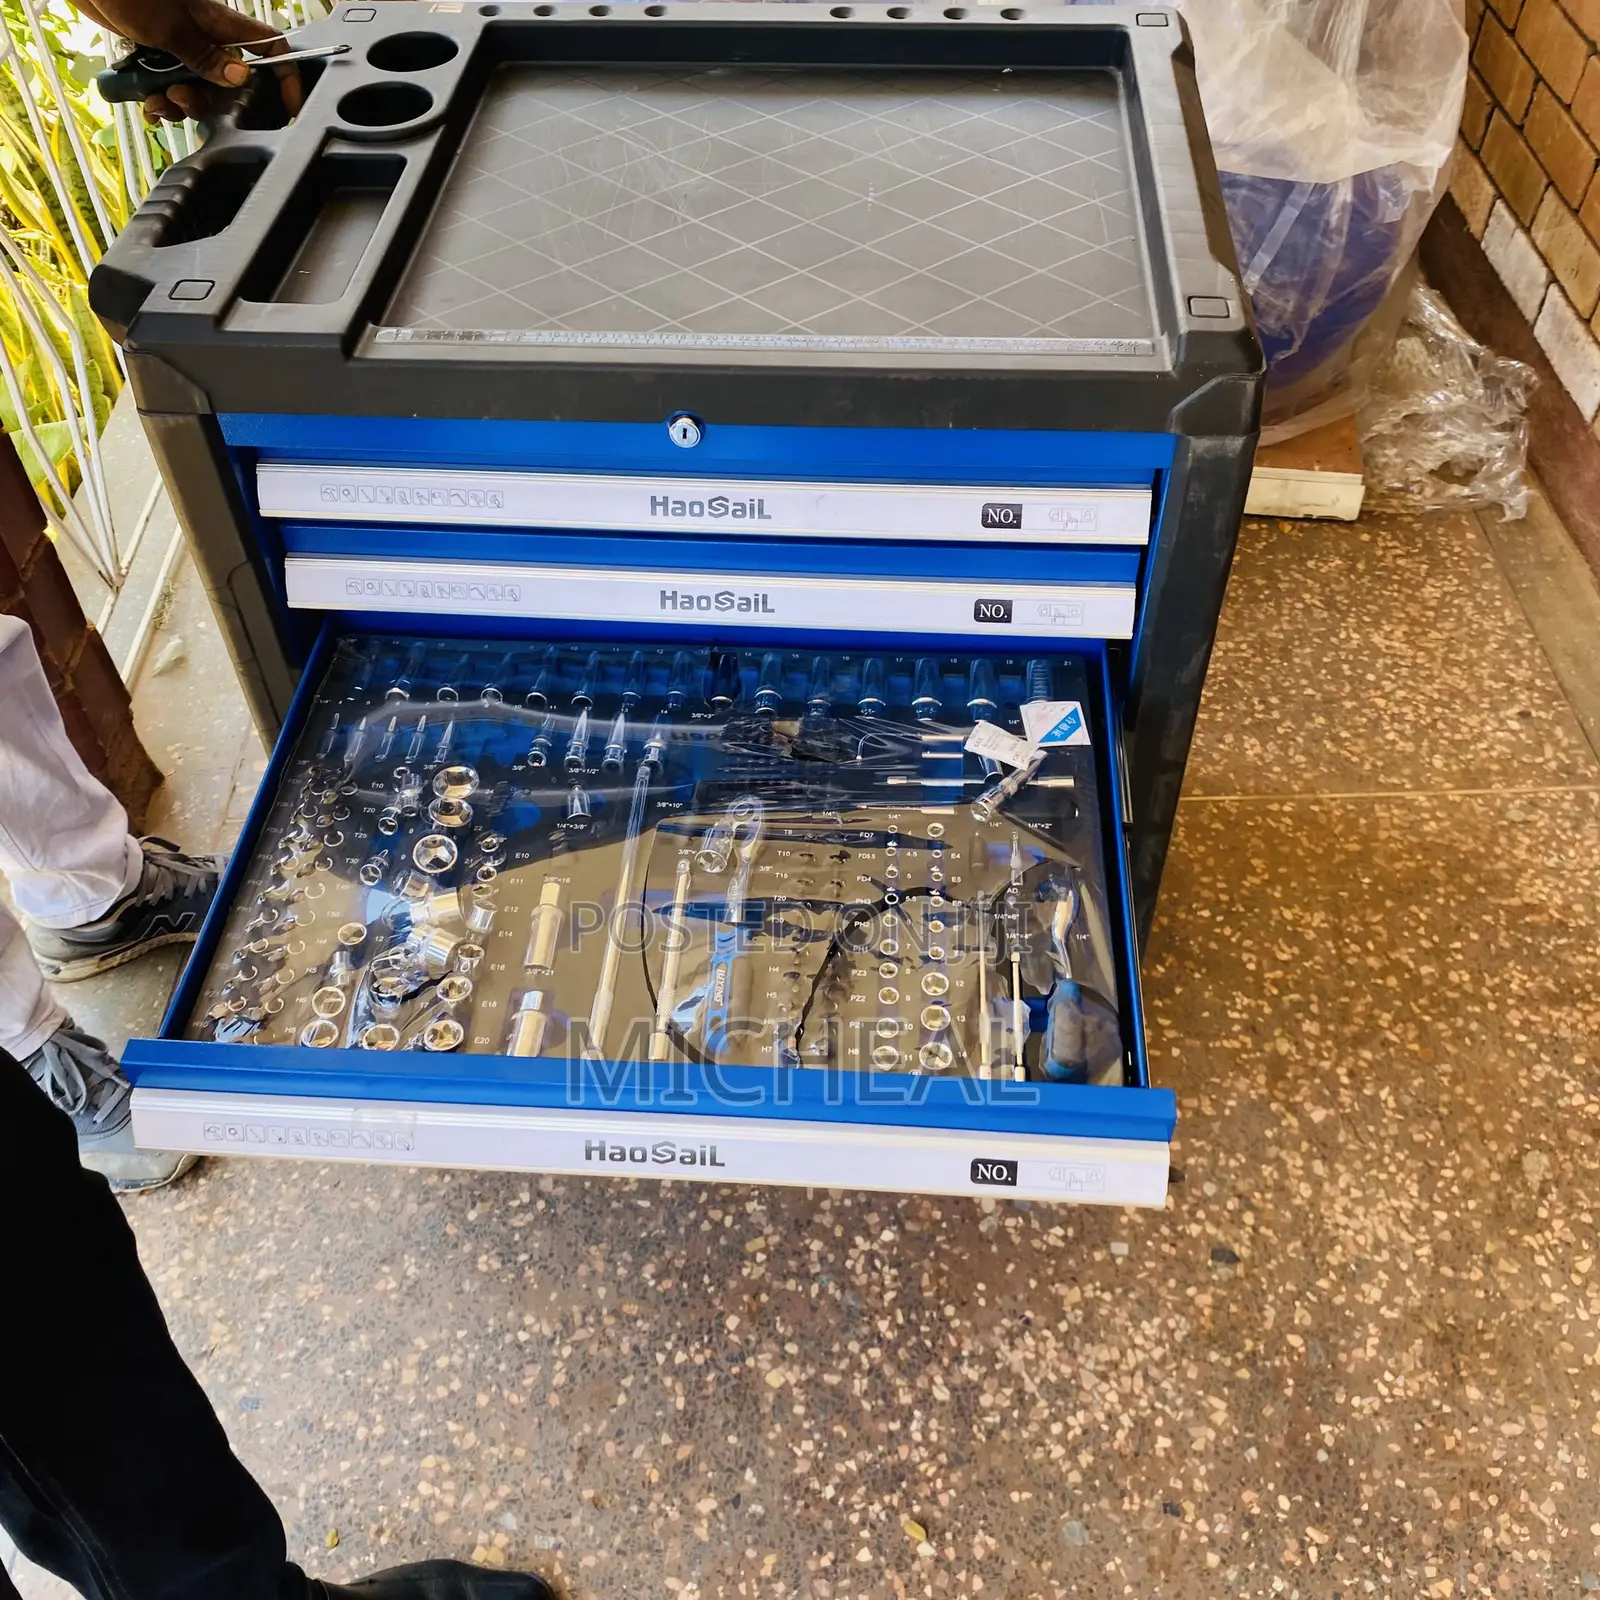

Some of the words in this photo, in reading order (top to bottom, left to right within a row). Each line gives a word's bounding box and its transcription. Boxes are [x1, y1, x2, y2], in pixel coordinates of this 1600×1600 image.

[987, 508, 1017, 524] NO.
[979, 604, 1008, 619] NO.
[498, 930, 513, 938] E14
[305, 966, 318, 974] H5
[490, 963, 506, 971] E16
[481, 1000, 497, 1008] E18
[474, 1036, 490, 1045] E20
[976, 1163, 1012, 1182] NO.
